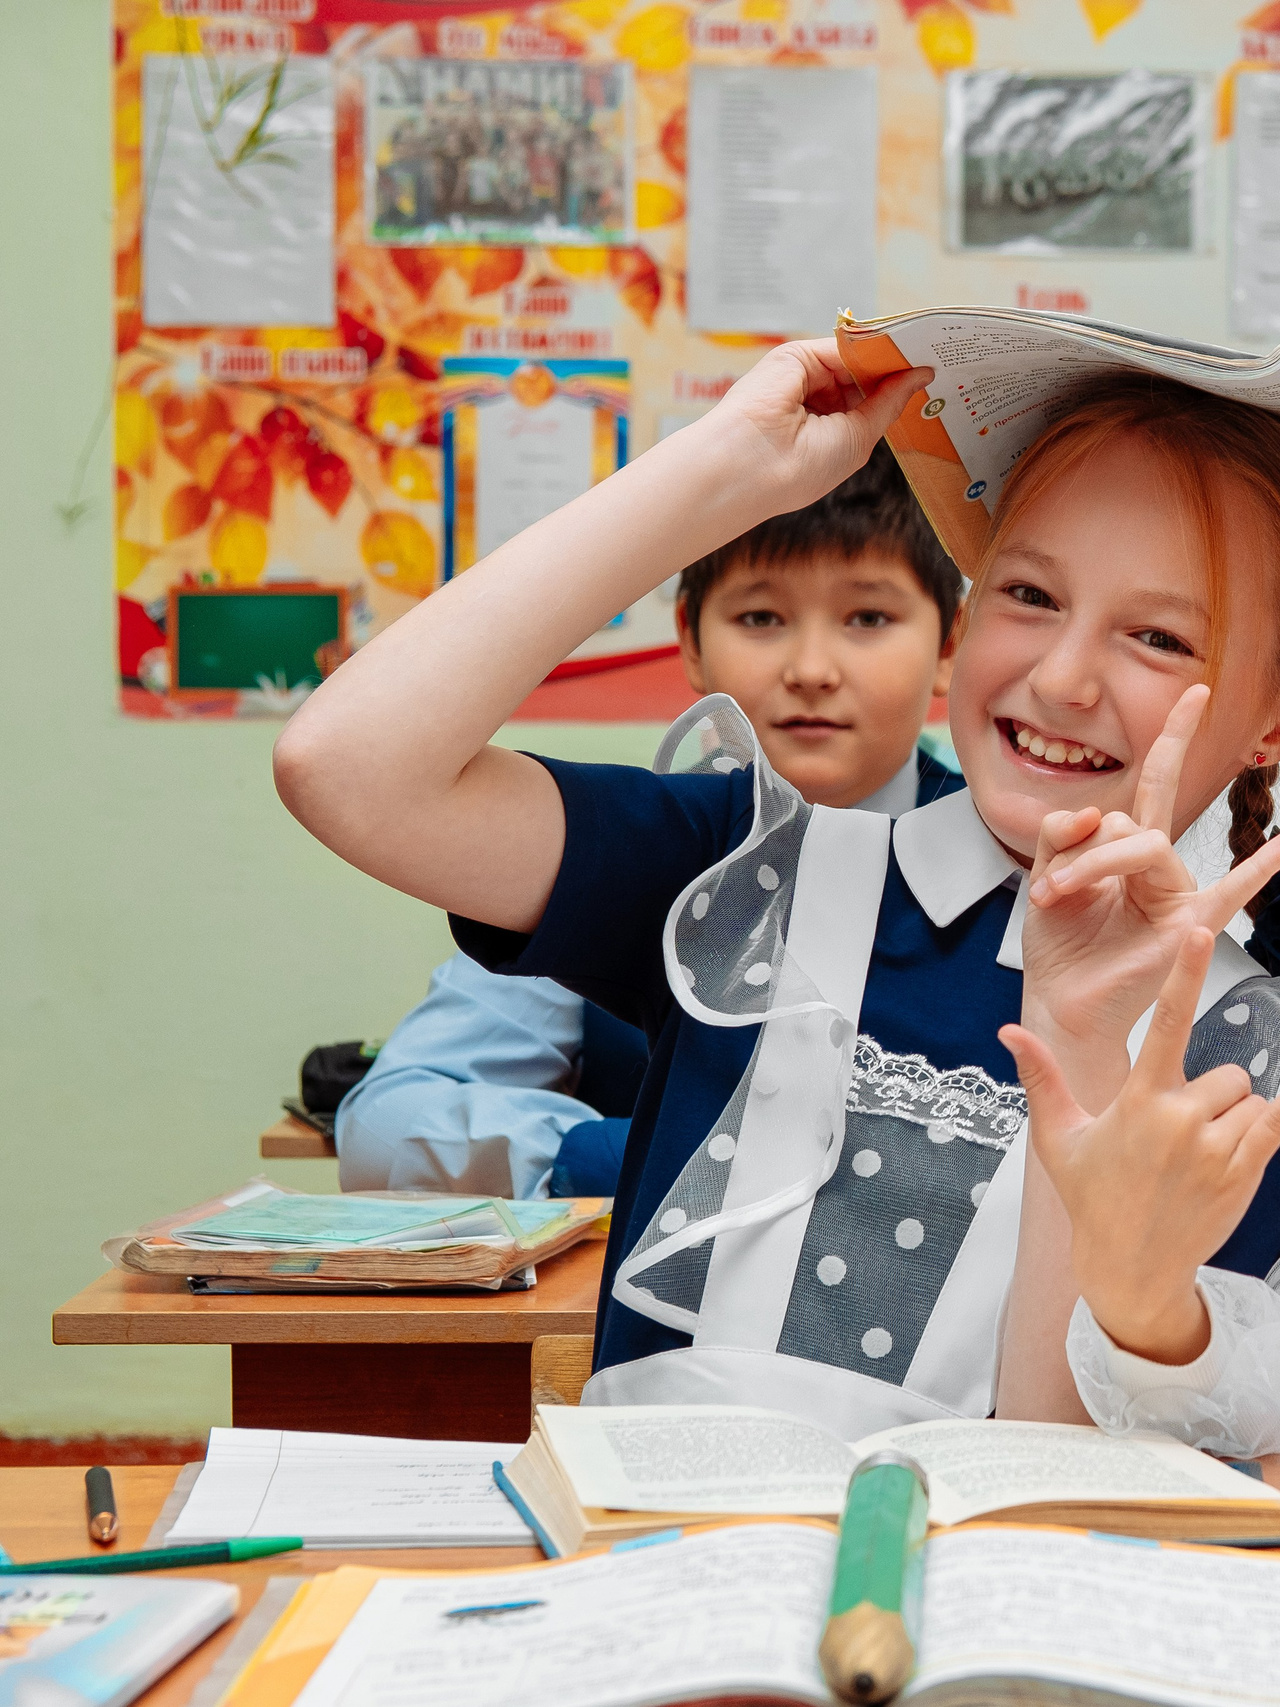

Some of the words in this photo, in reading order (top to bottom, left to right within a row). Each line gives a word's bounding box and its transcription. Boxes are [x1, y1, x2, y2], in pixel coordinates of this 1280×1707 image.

[959, 376, 1017, 398] выполнили
[965, 393, 996, 411] время
[1002, 381, 1037, 394] других
[978, 375, 1047, 396] Подчеркните
[984, 384, 1039, 409] Образуйте
[972, 391, 1033, 424] прошедшего
[993, 395, 1061, 429] Произносите
